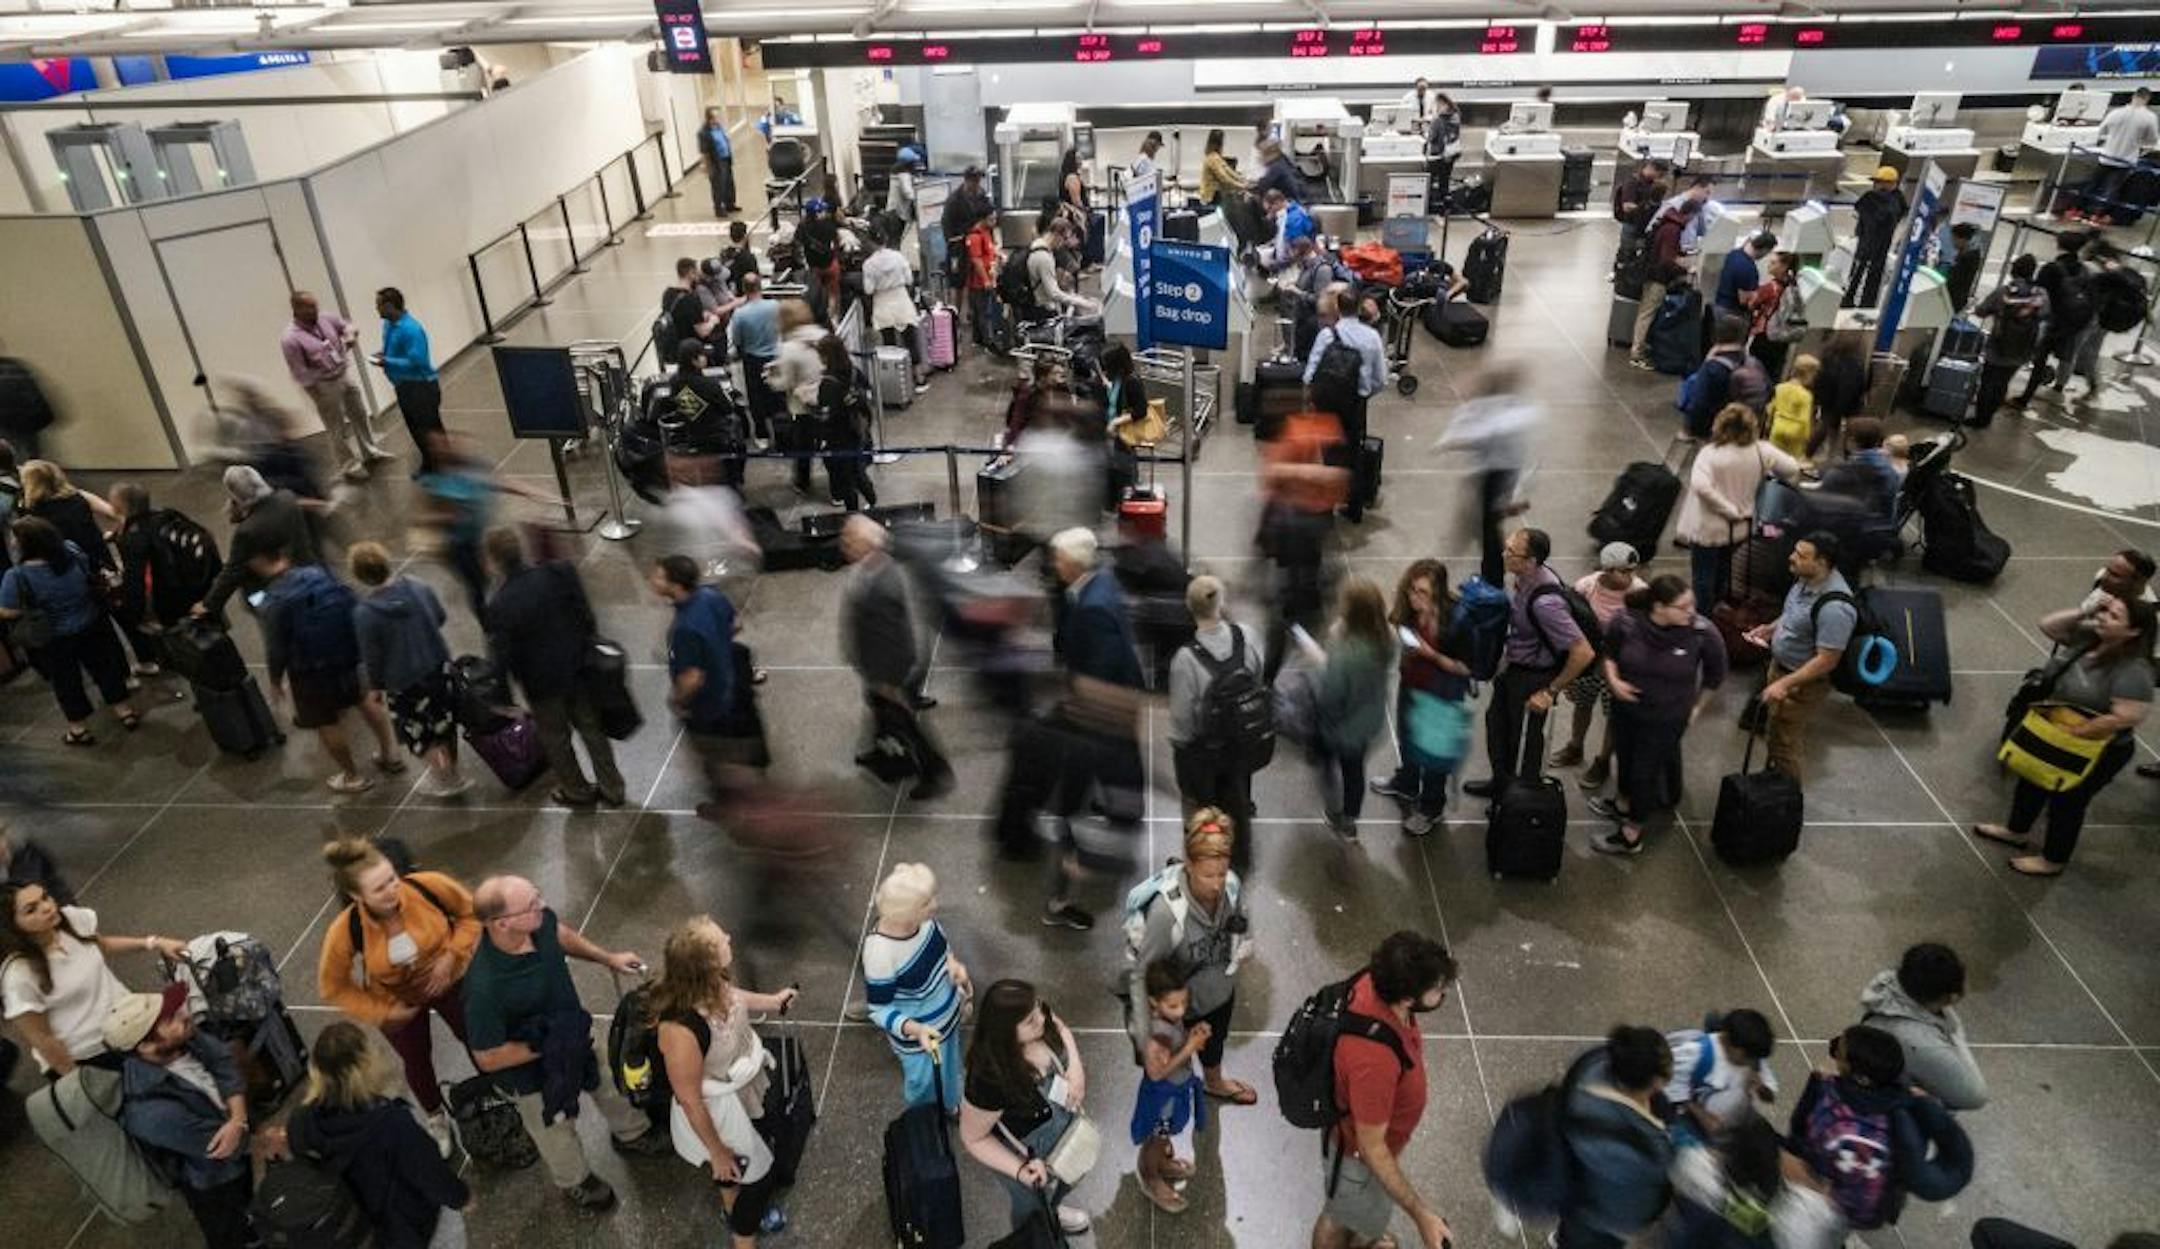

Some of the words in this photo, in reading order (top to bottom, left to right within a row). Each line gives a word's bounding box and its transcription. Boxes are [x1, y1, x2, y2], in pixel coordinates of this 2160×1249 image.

[1167, 248, 1202, 259] UNITED
[1154, 281, 1184, 299] Step
[1154, 304, 1180, 323] Bag
[1181, 307, 1213, 325] drop
